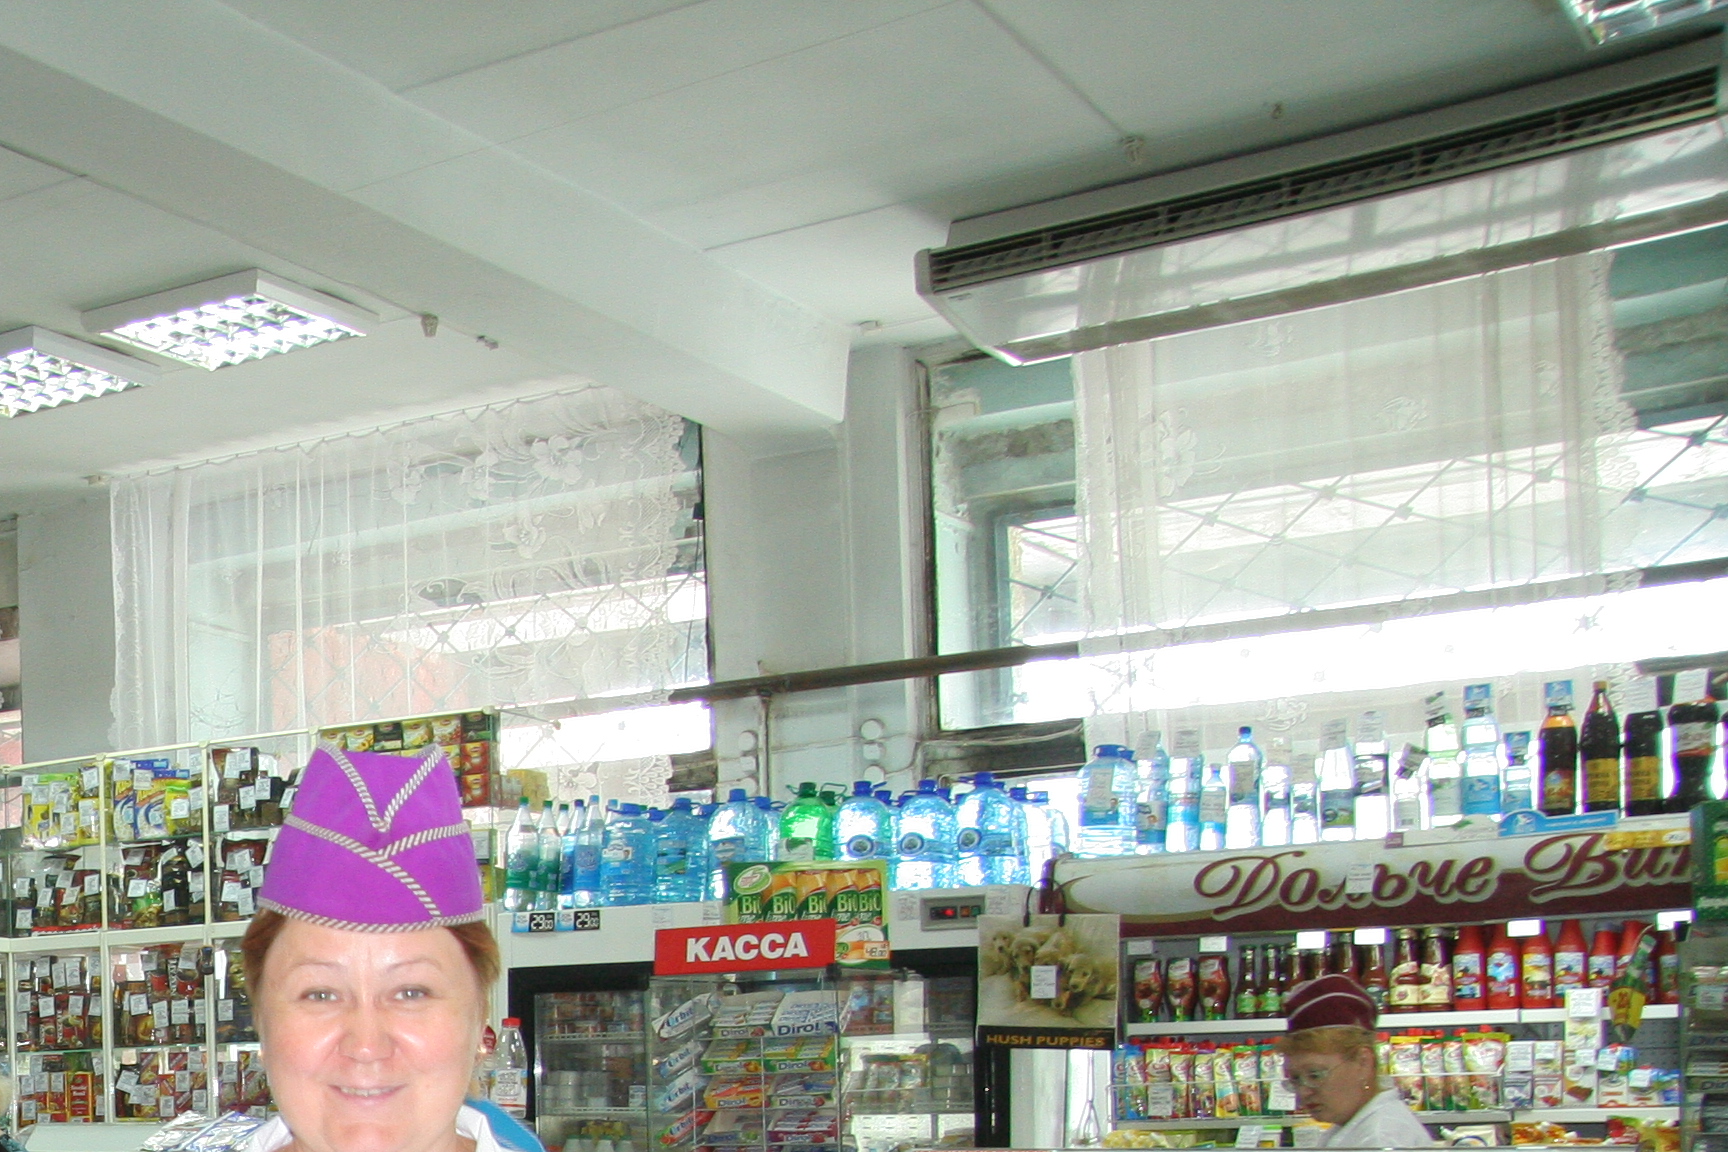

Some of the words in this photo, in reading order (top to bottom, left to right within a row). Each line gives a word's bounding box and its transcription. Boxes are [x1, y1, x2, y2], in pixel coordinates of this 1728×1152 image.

[685, 932, 809, 963] КАССА
[777, 1022, 821, 1037] Dirol
[986, 1034, 1033, 1046] HUSH
[1036, 1036, 1106, 1047] PUPPIES
